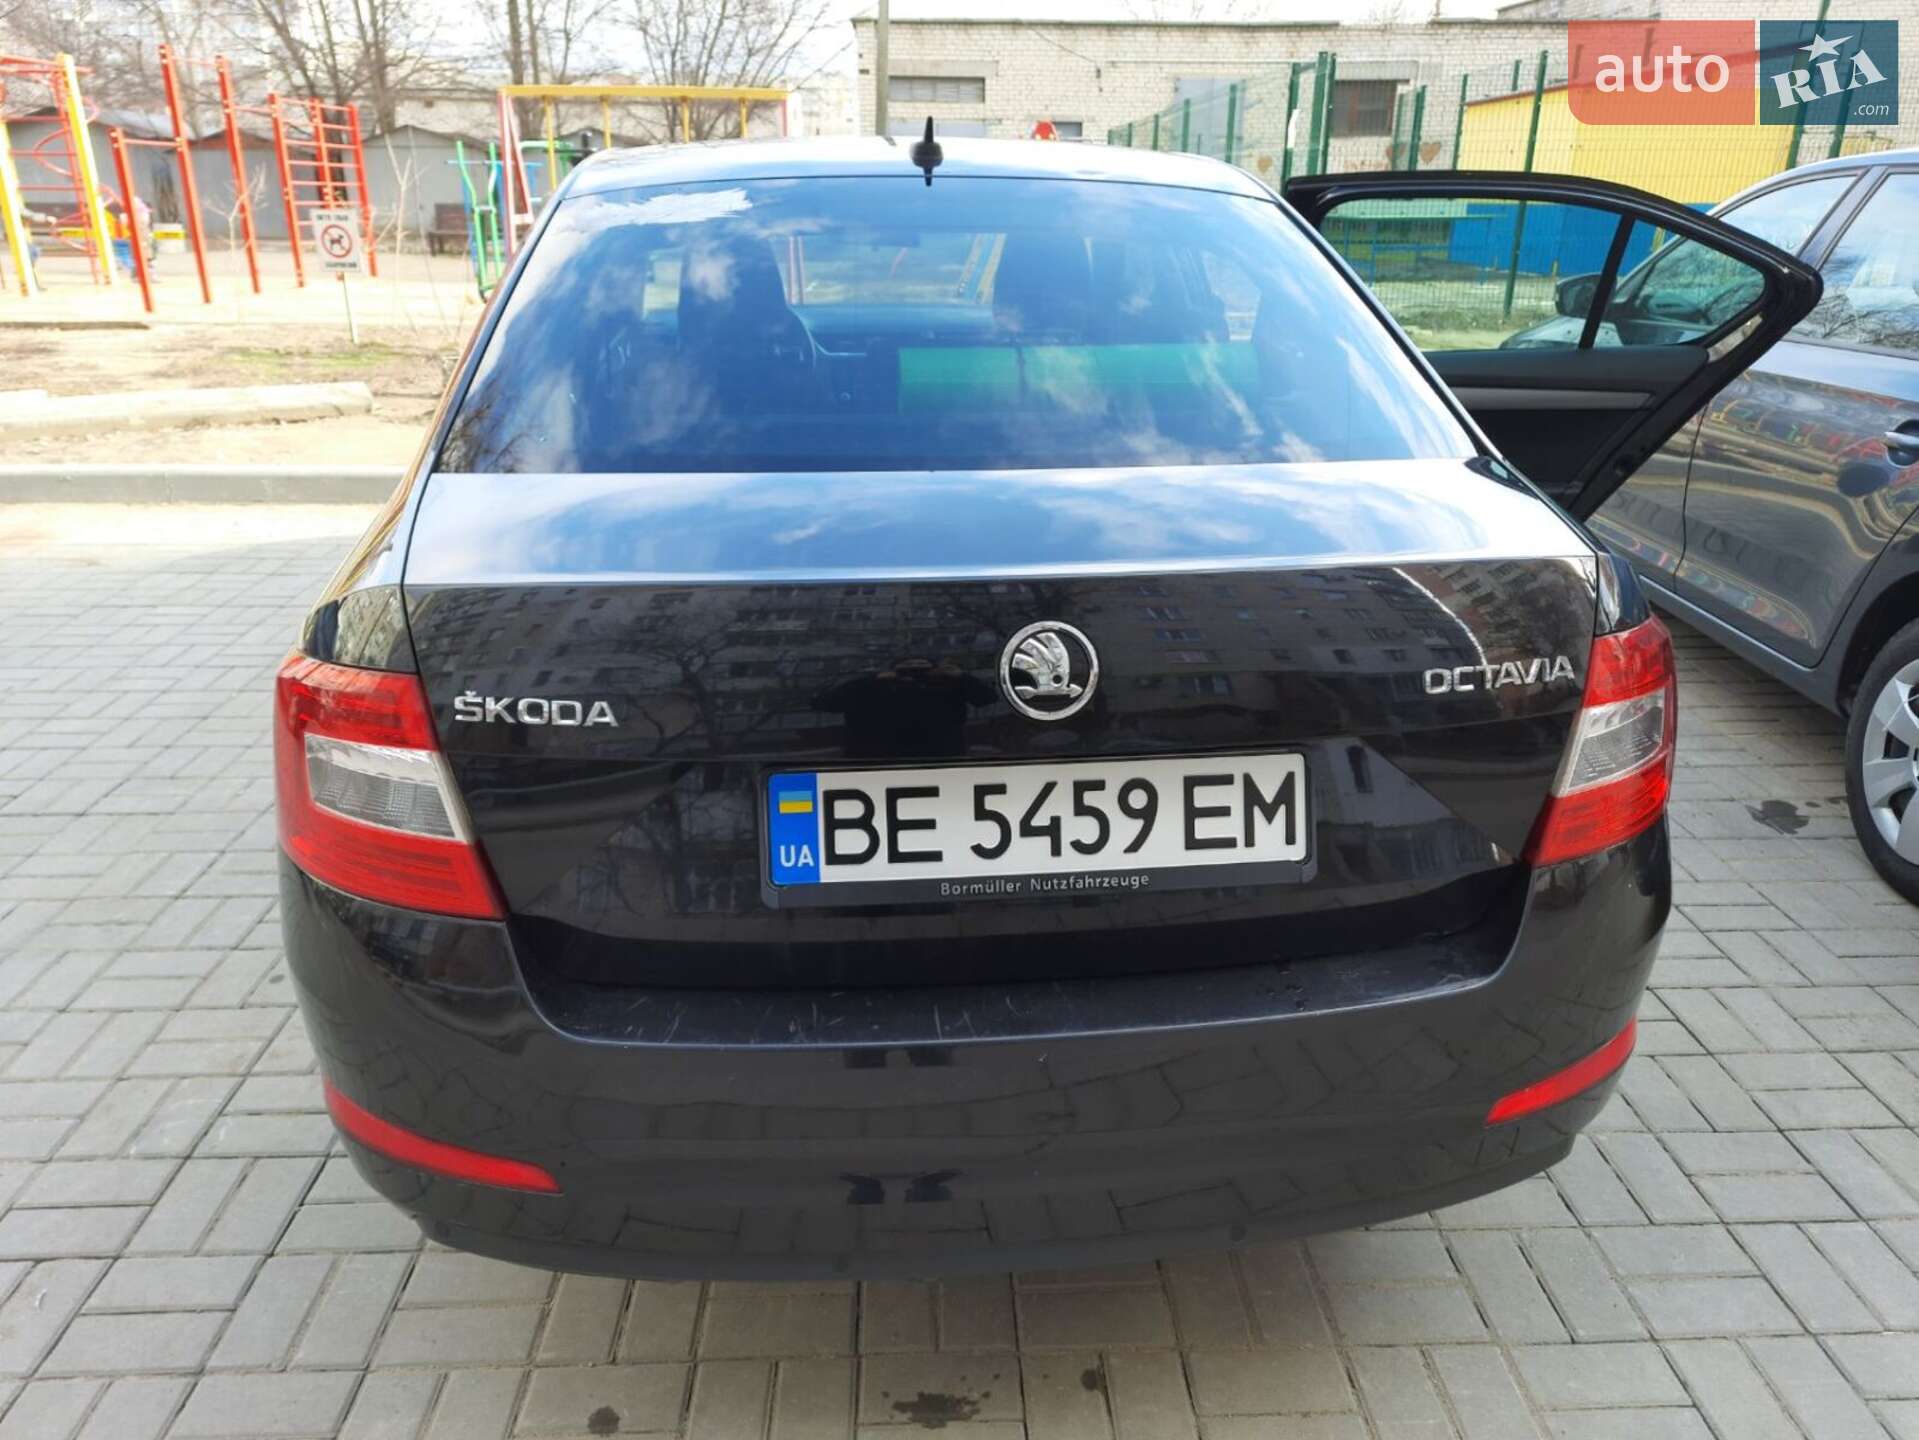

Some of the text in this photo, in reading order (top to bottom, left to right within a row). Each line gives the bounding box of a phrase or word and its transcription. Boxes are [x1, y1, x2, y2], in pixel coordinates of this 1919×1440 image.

[1424, 655, 1575, 694] OCTAVIA
[454, 690, 619, 727] ŠKODA
[822, 771, 1296, 866] BE 5459 EM
[779, 844, 814, 868] UA
[940, 873, 1150, 896] Bormüller Nutzfahrzeuge
